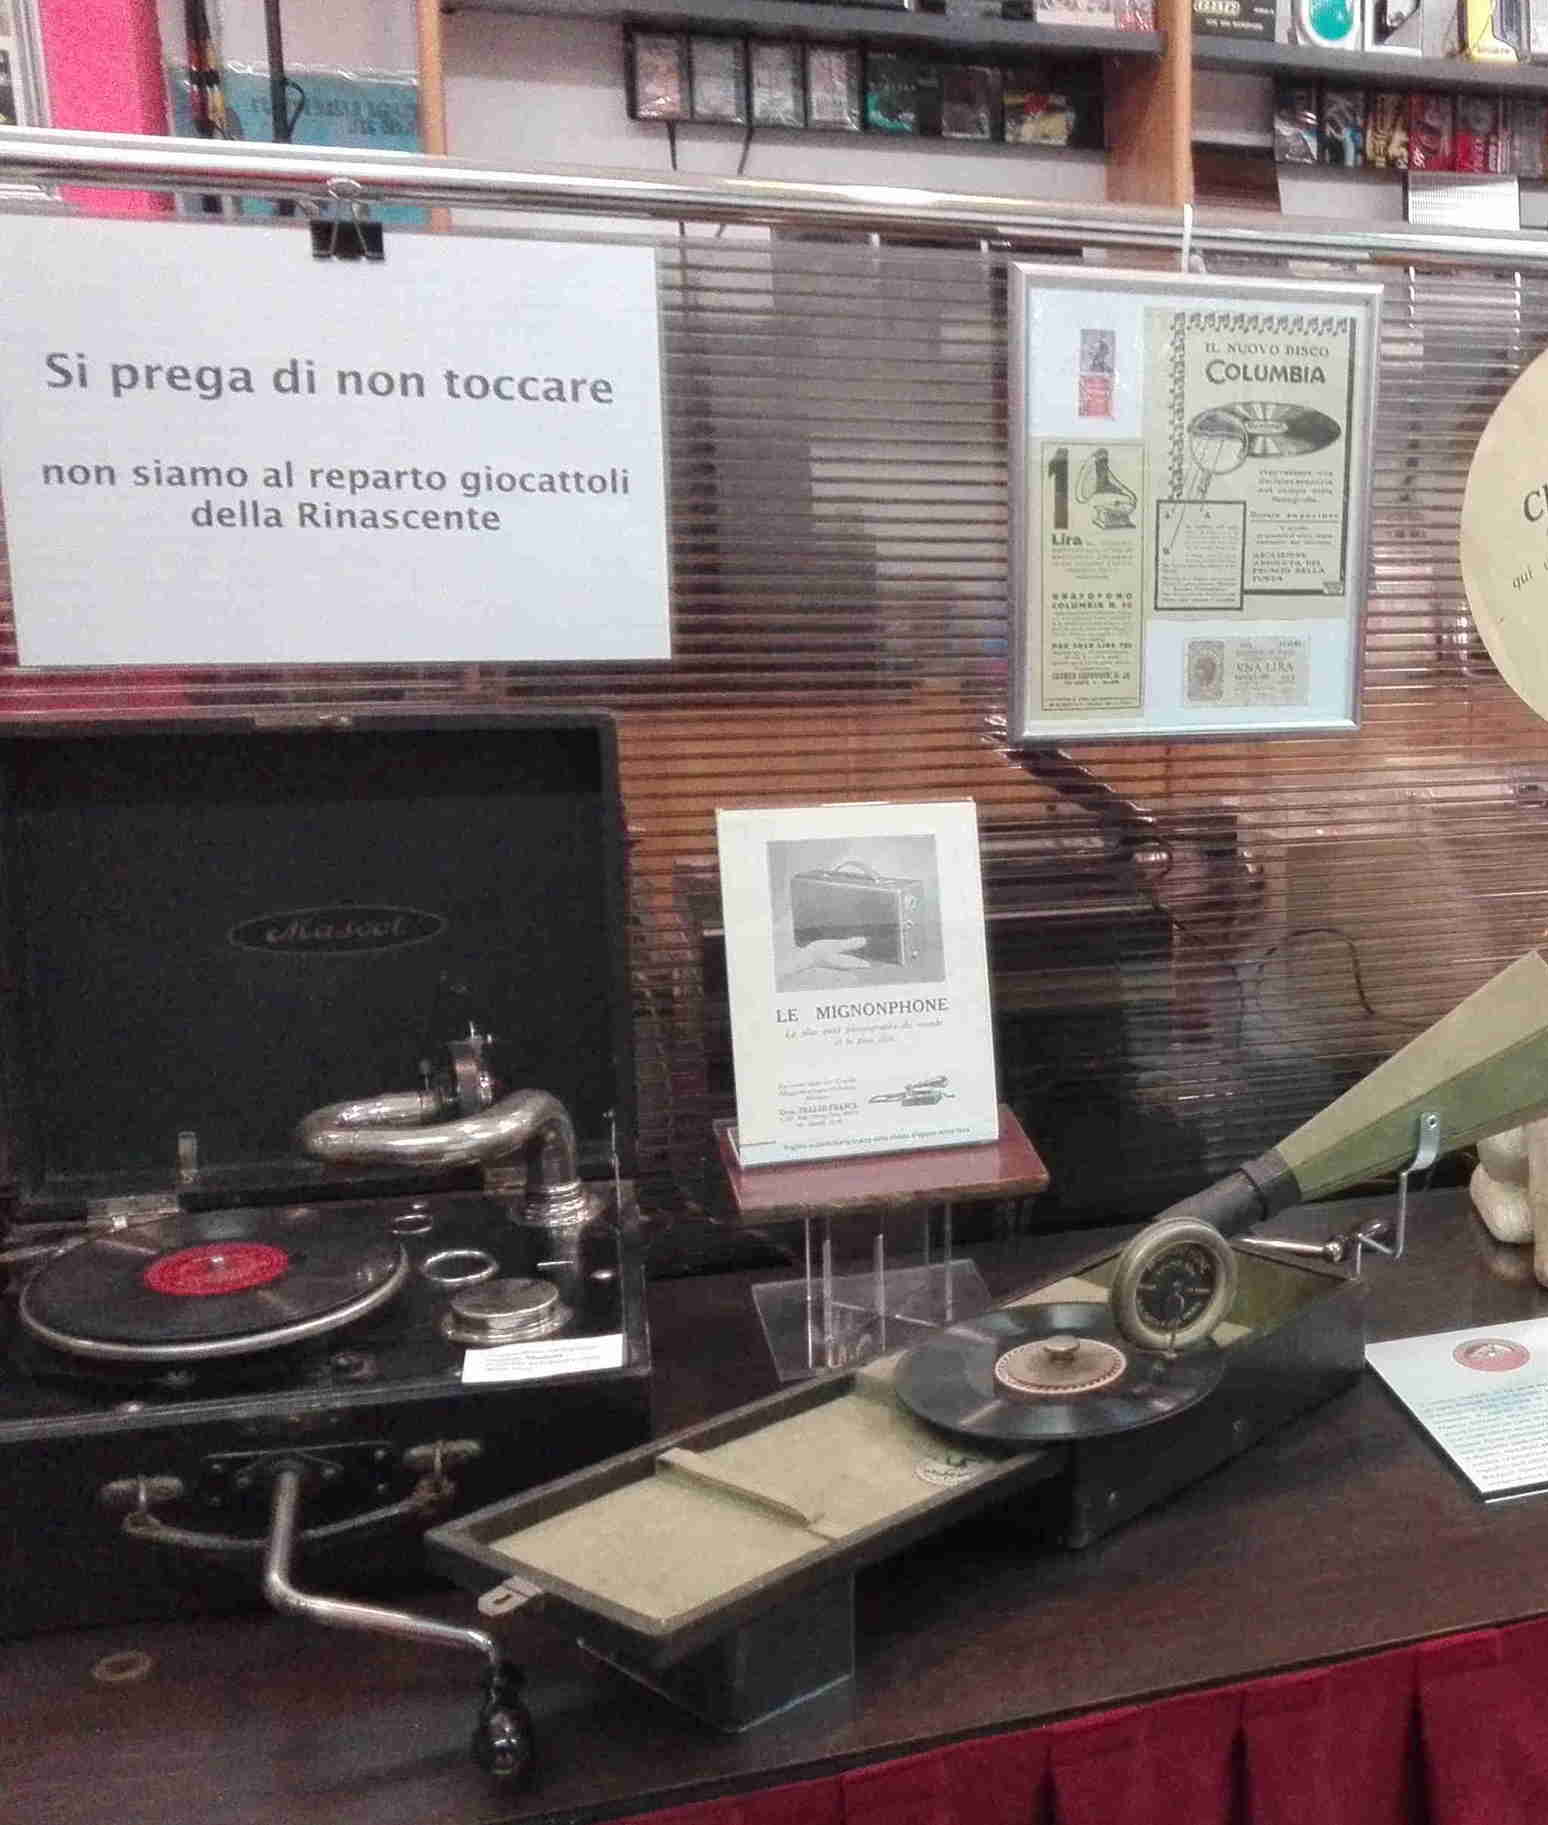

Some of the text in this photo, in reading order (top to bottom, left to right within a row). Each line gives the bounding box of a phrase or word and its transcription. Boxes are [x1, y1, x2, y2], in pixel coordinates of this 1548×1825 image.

[1205, 342, 1330, 358] IL NUOVO DISCO
[46, 353, 615, 405] Si prega di non toccare
[1205, 359, 1326, 385] COLUMBIA
[42, 459, 632, 499] non siamo al reparto giocattoli
[191, 500, 502, 532] della Rinascente
[1051, 533, 1083, 547] Lira
[1512, 566, 1533, 592] qui
[775, 997, 951, 1024] LE MIGNONPHONE
